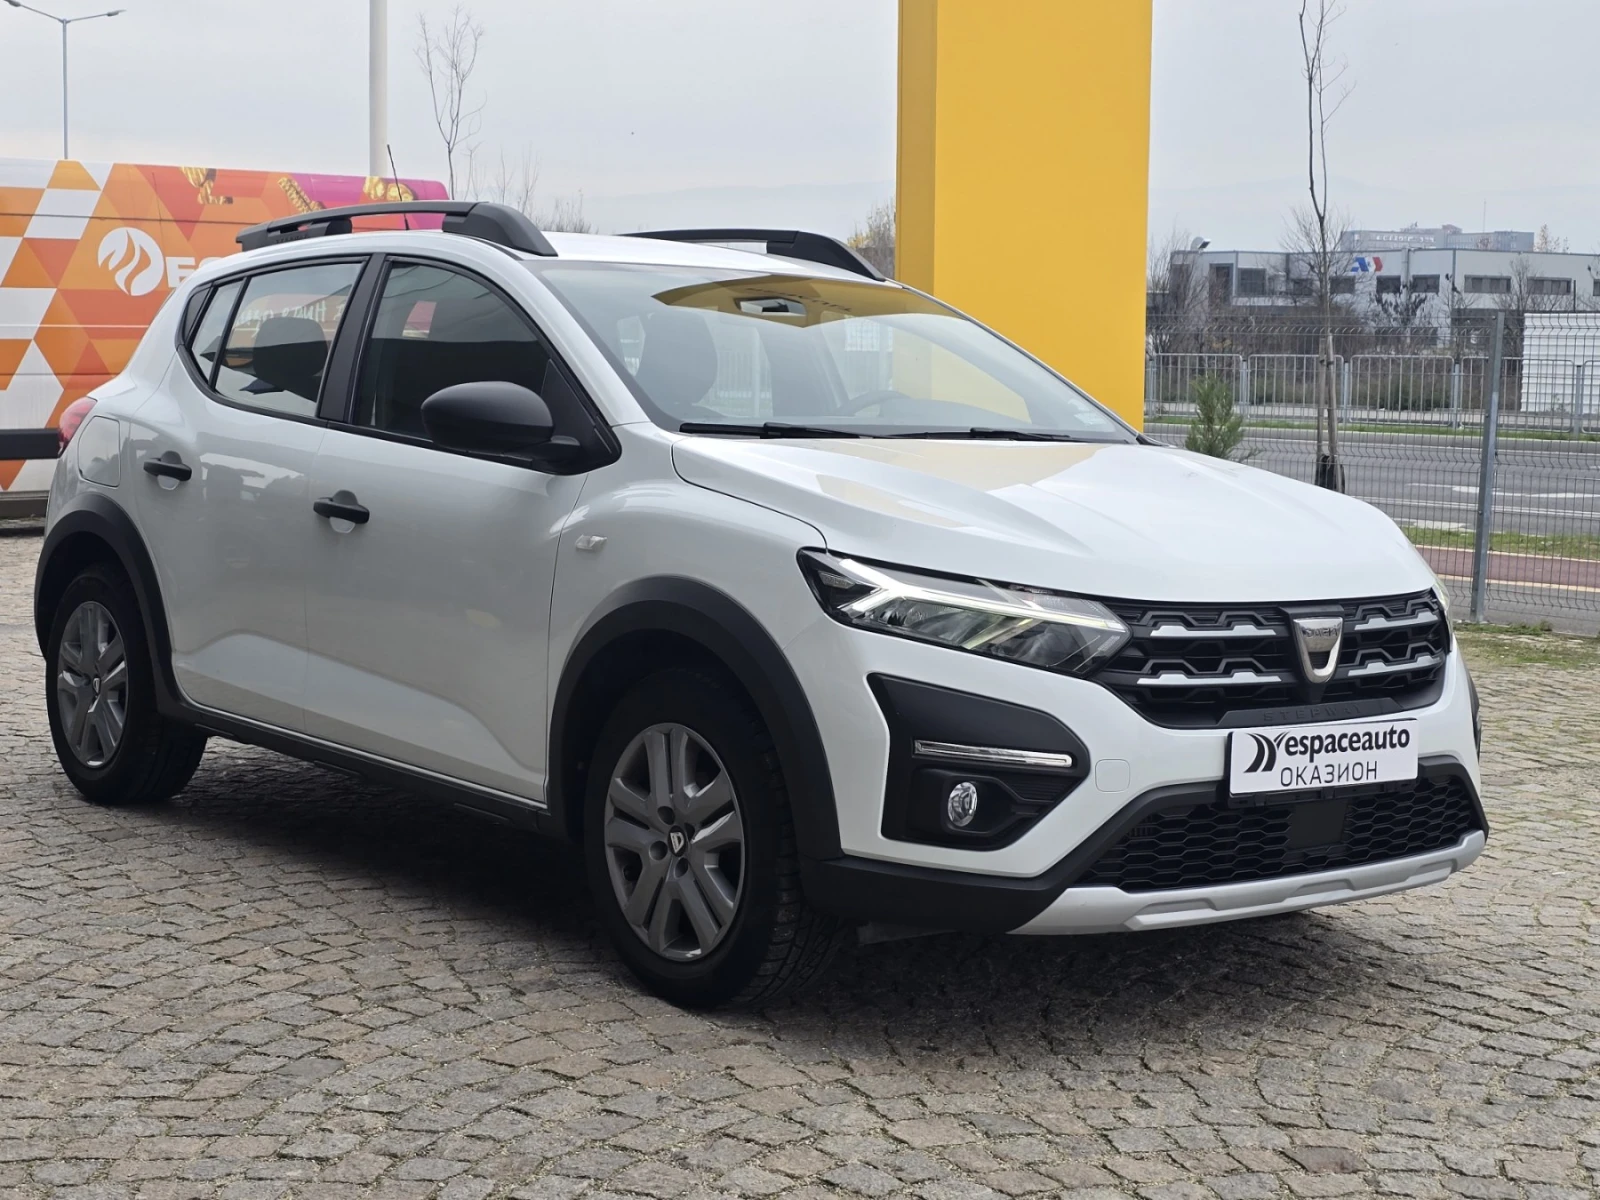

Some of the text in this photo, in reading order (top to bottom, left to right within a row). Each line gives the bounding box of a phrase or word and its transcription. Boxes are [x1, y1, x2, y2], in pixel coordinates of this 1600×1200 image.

[1263, 704, 1362, 721] STEPWAY
[1285, 725, 1410, 763] espaceauto
[1280, 761, 1377, 787] ОКАЗИОН
